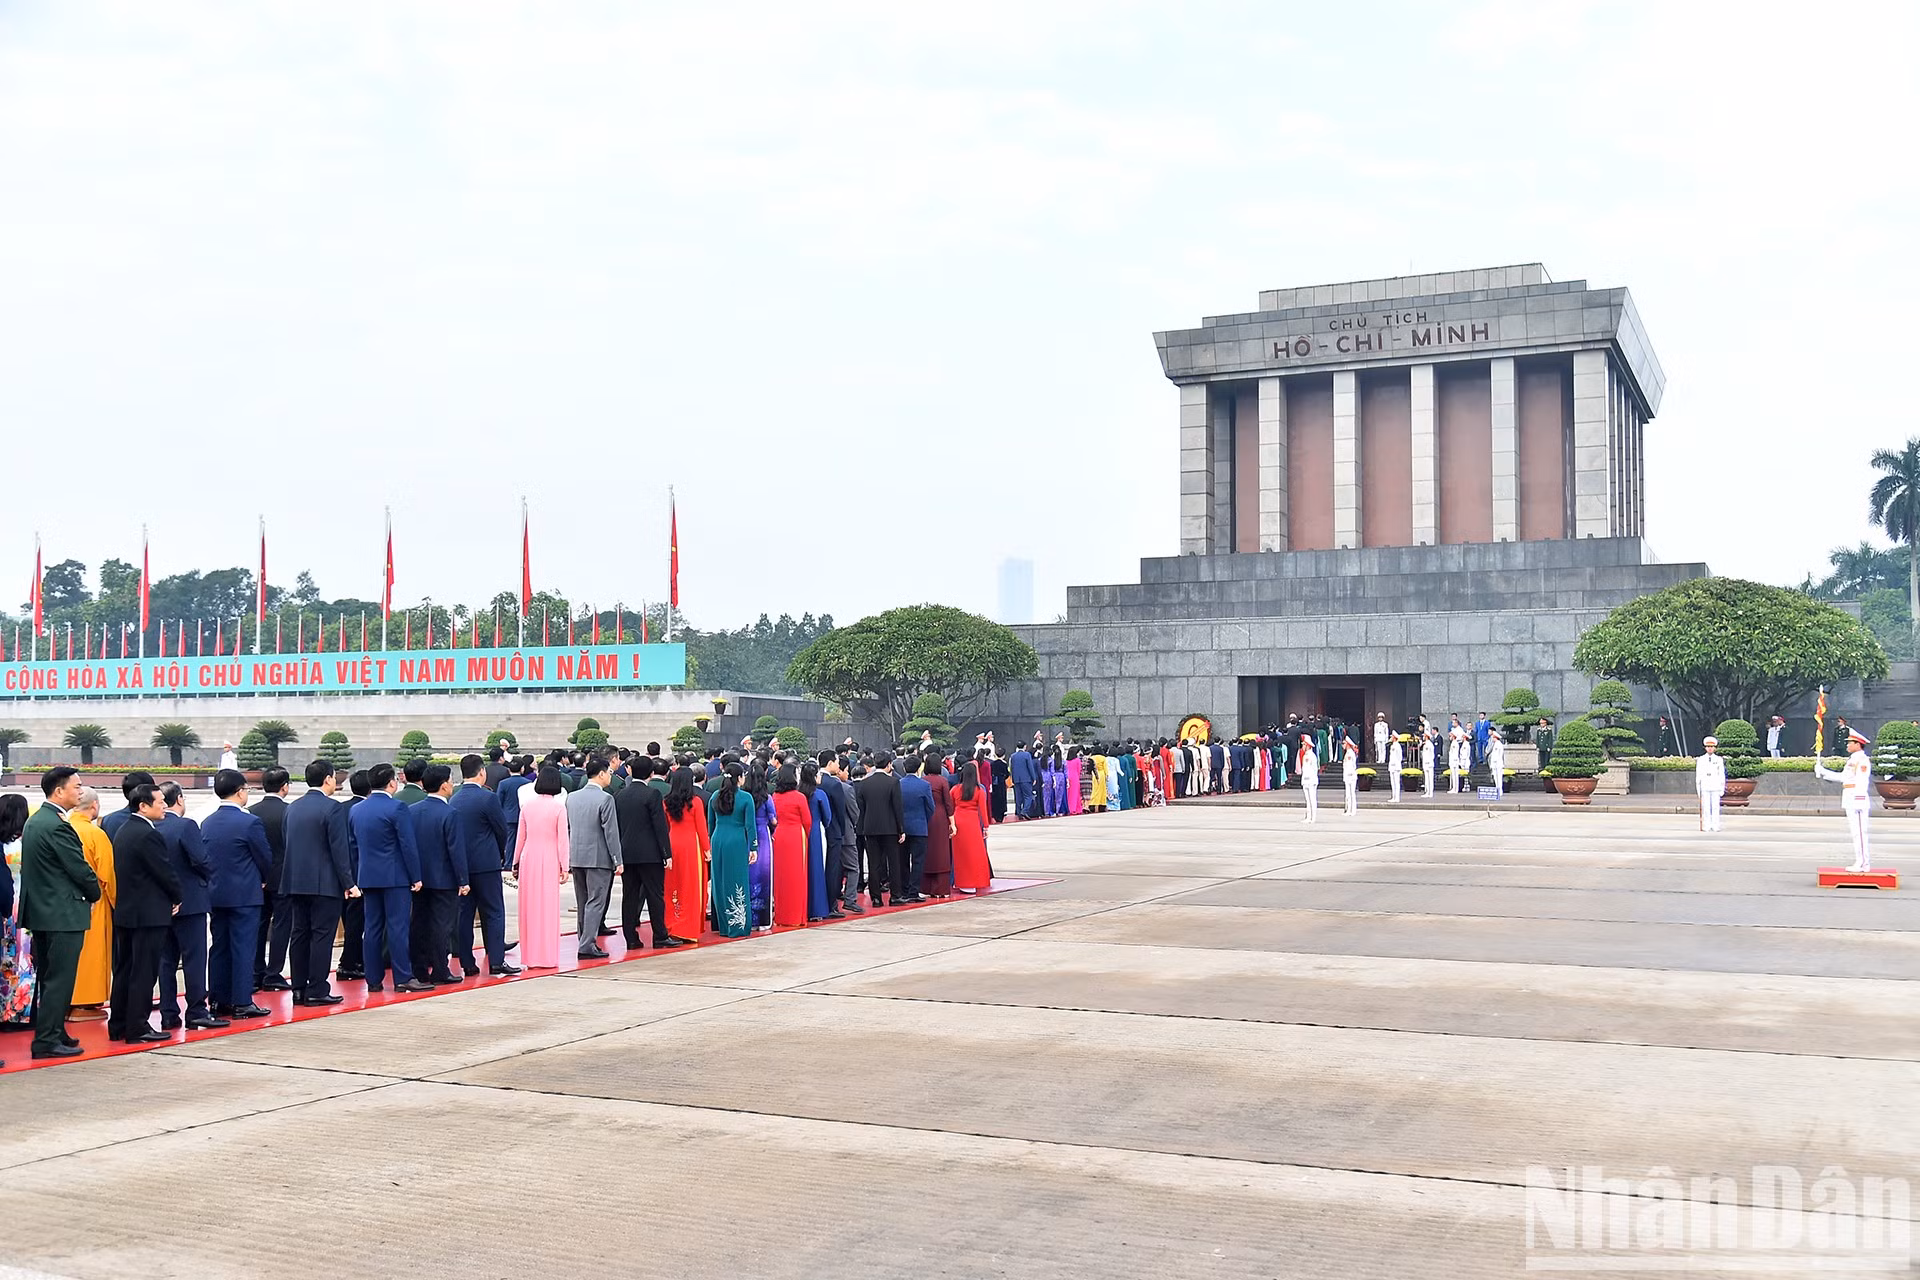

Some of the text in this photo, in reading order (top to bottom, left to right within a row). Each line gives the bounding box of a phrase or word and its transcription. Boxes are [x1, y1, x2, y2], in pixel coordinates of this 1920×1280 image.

[5, 665, 58, 694] CỘNG
[67, 664, 107, 689] HÒA
[117, 662, 143, 688] XÃ
[153, 661, 188, 691] HỘI
[199, 657, 243, 687] CHỦ
[253, 658, 323, 686] NGHĨA
[336, 655, 387, 688] VIỆT
[400, 657, 455, 683] NAM
[467, 651, 544, 682] MUÔN
[557, 649, 618, 681] NĂM
